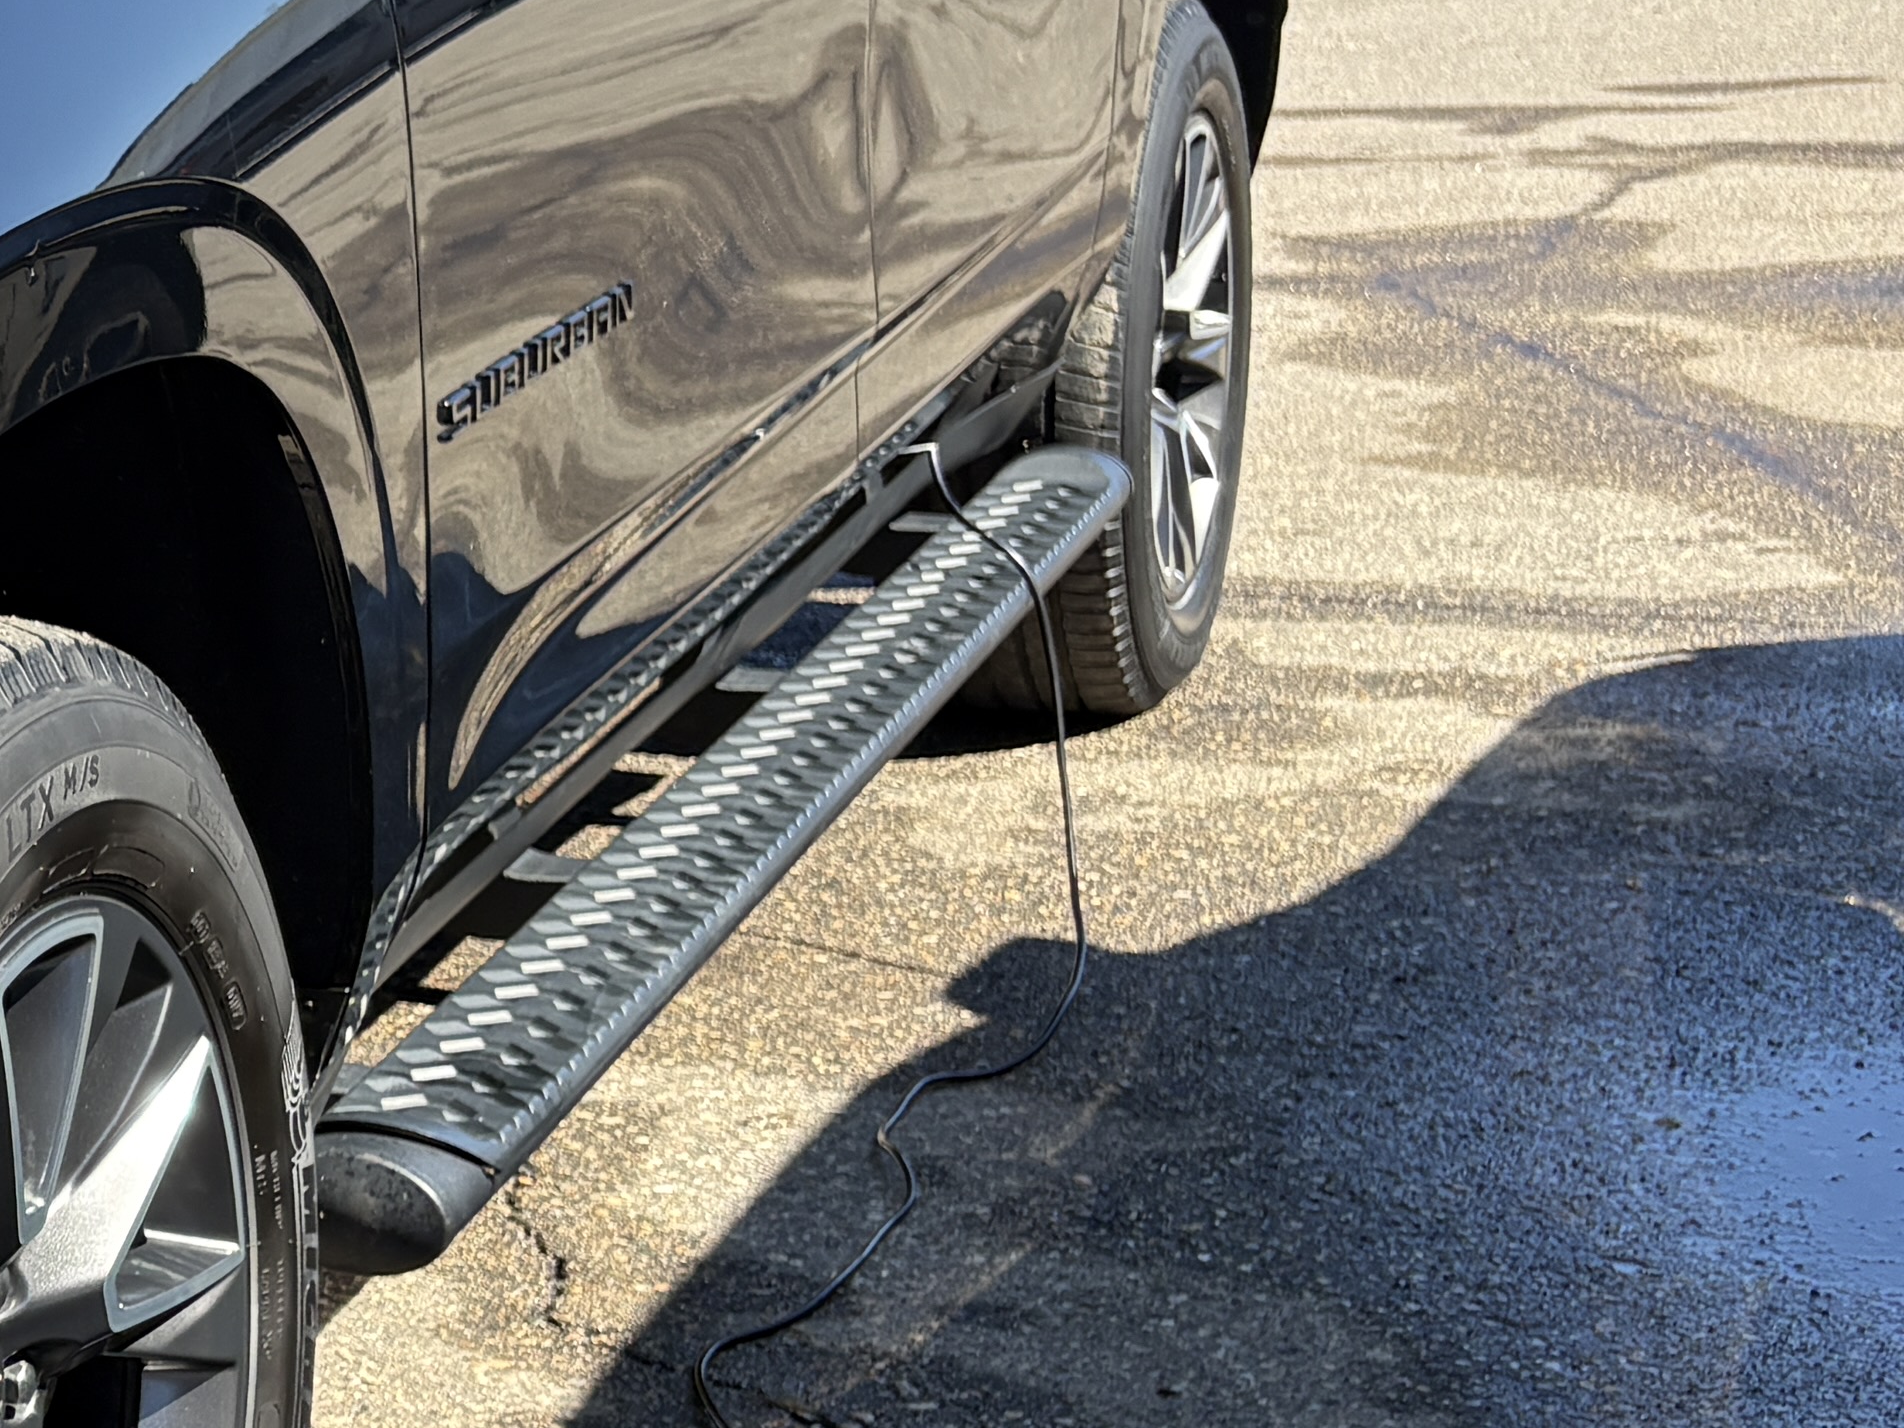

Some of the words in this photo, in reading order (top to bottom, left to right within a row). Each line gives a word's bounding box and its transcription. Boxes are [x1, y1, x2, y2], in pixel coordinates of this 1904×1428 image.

[437, 279, 634, 443] SUBURBAN
[5, 775, 54, 863] LTX
[63, 754, 100, 801] M/S
